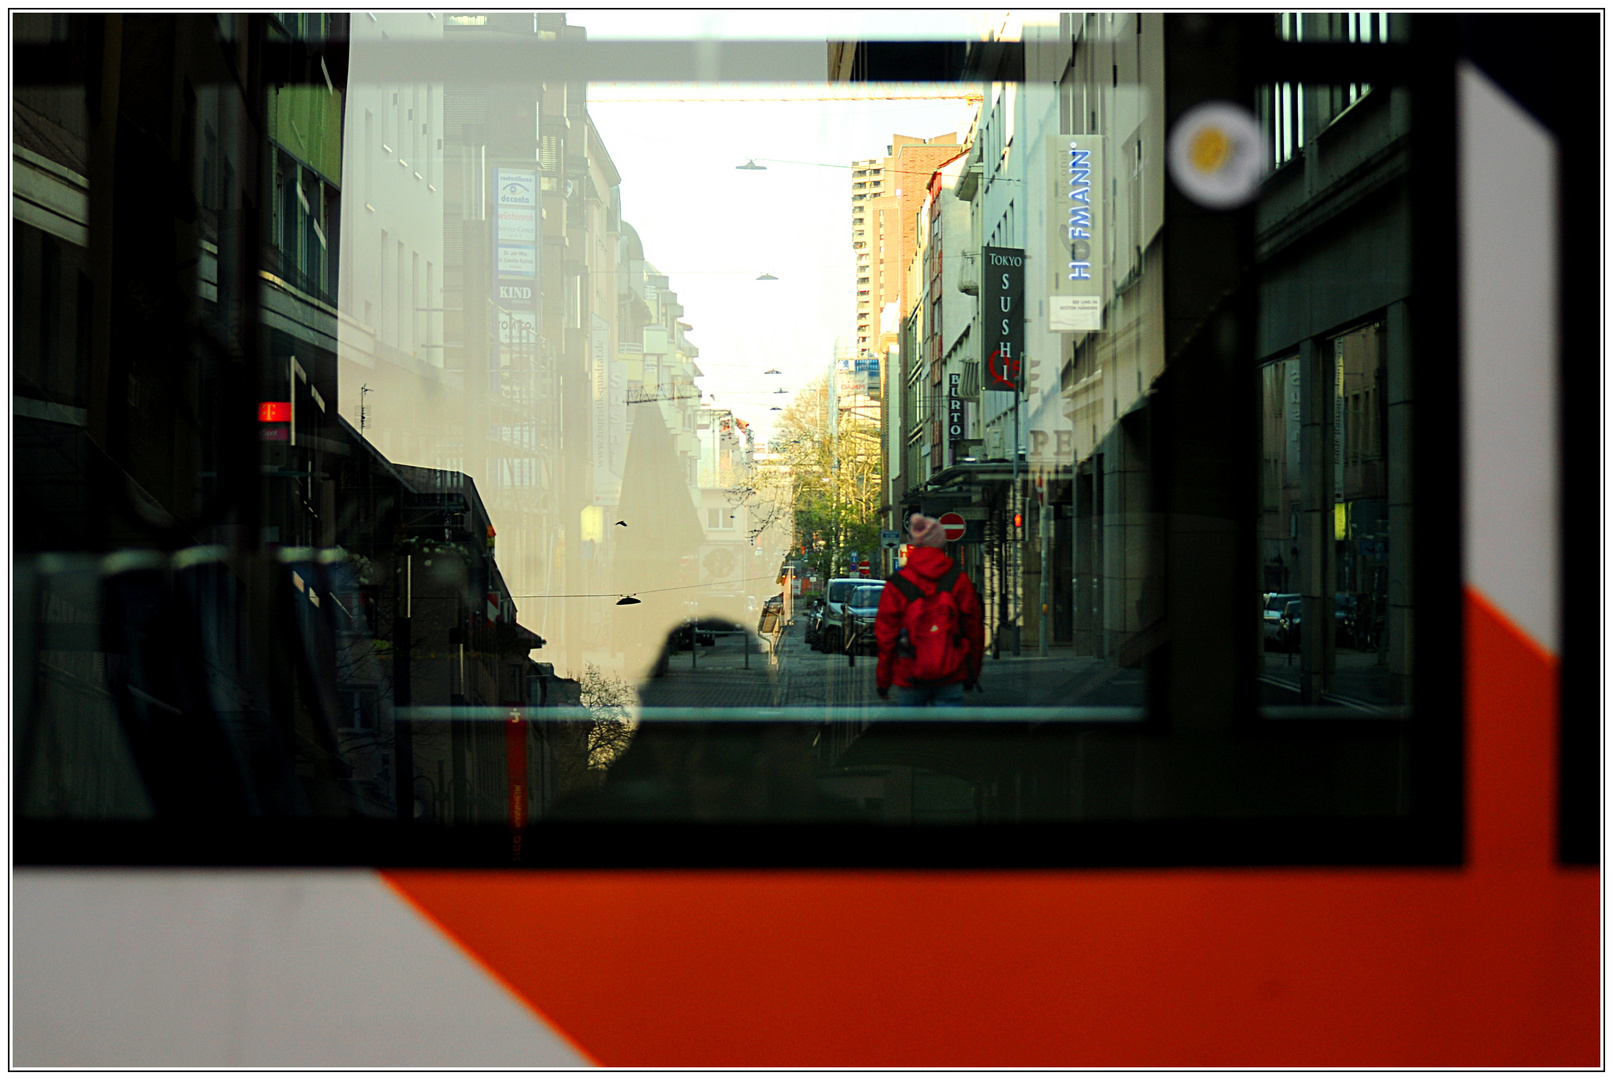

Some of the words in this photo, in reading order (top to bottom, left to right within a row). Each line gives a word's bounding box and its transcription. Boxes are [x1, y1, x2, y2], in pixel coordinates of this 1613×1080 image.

[989, 252, 1022, 268] TOKYO
[499, 286, 532, 299] KIND
[1000, 273, 1011, 381] SUSHI
